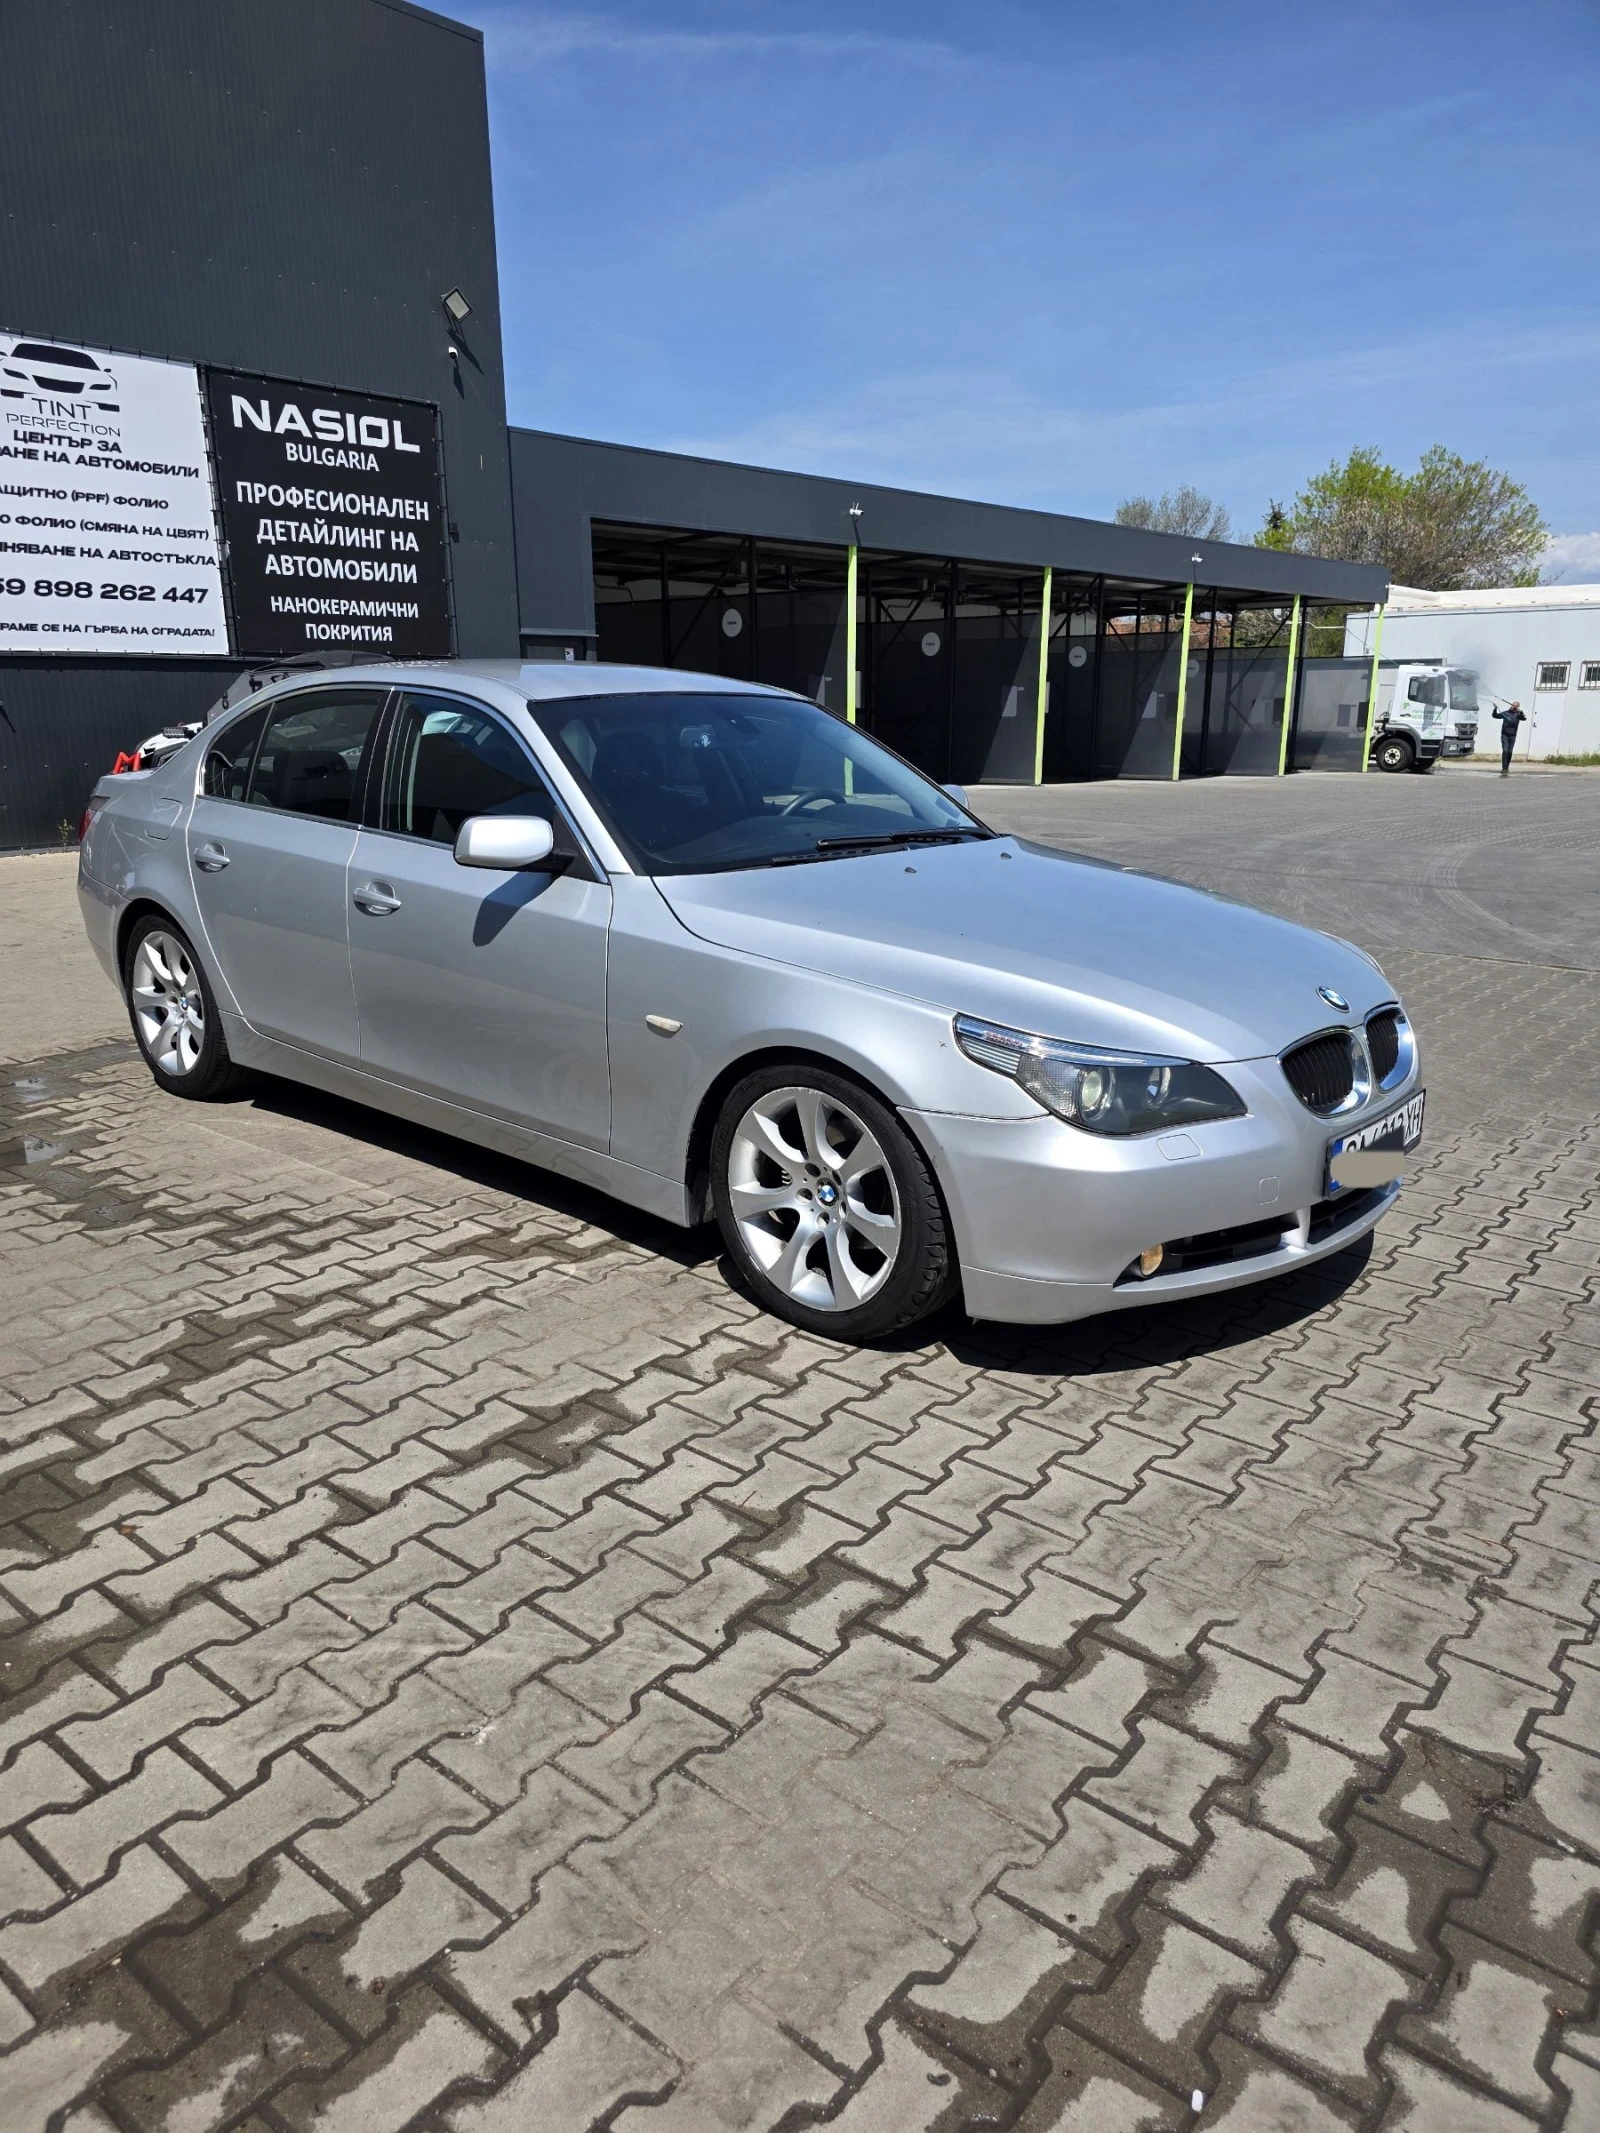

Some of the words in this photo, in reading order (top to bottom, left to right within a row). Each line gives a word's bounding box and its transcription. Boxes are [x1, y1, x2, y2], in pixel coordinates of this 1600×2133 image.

[31, 397, 92, 420] TINT
[6, 413, 121, 437] PERFECTION
[231, 394, 421, 453] NASIOL
[14, 429, 93, 449] ЦЕНТЪР
[97, 440, 122, 453] ЗА
[0, 445, 39, 461] АНЕ
[44, 449, 71, 464] НА
[75, 454, 199, 478] АВТОМОБИЛИ
[285, 442, 380, 472] BULGARIA
[71, 489, 109, 505] (PPF)
[113, 495, 169, 510] ФОЛИО
[236, 481, 430, 521] ПРОФЕСИОНАЛЕН
[15, 515, 76, 530] ФОЛИО
[80, 519, 139, 535] (СМЯНА
[142, 525, 163, 537] НА
[166, 527, 209, 541] ЦВЯТ)
[257, 518, 385, 550] ДЕТАЙЛИНГ
[391, 530, 419, 552] НА
[0, 541, 76, 557] НЯВАНЕ
[80, 547, 104, 559] НА
[107, 549, 216, 566] АВТОСТЪКЛА
[265, 553, 418, 583] АВТОМОБИЛИ
[0, 577, 26, 596] 9
[34, 579, 94, 599] 898
[100, 583, 156, 601] 262
[162, 586, 209, 604] 447
[270, 595, 419, 619] НАНОКЕРАМИЧНИ
[41, 623, 60, 632] СЕ
[63, 624, 82, 633] НА
[85, 625, 128, 635] ГЪРБА
[131, 626, 149, 635] НА
[151, 627, 215, 637] СГРАДАТА!
[305, 623, 392, 642] ПОКРИТИЯ
